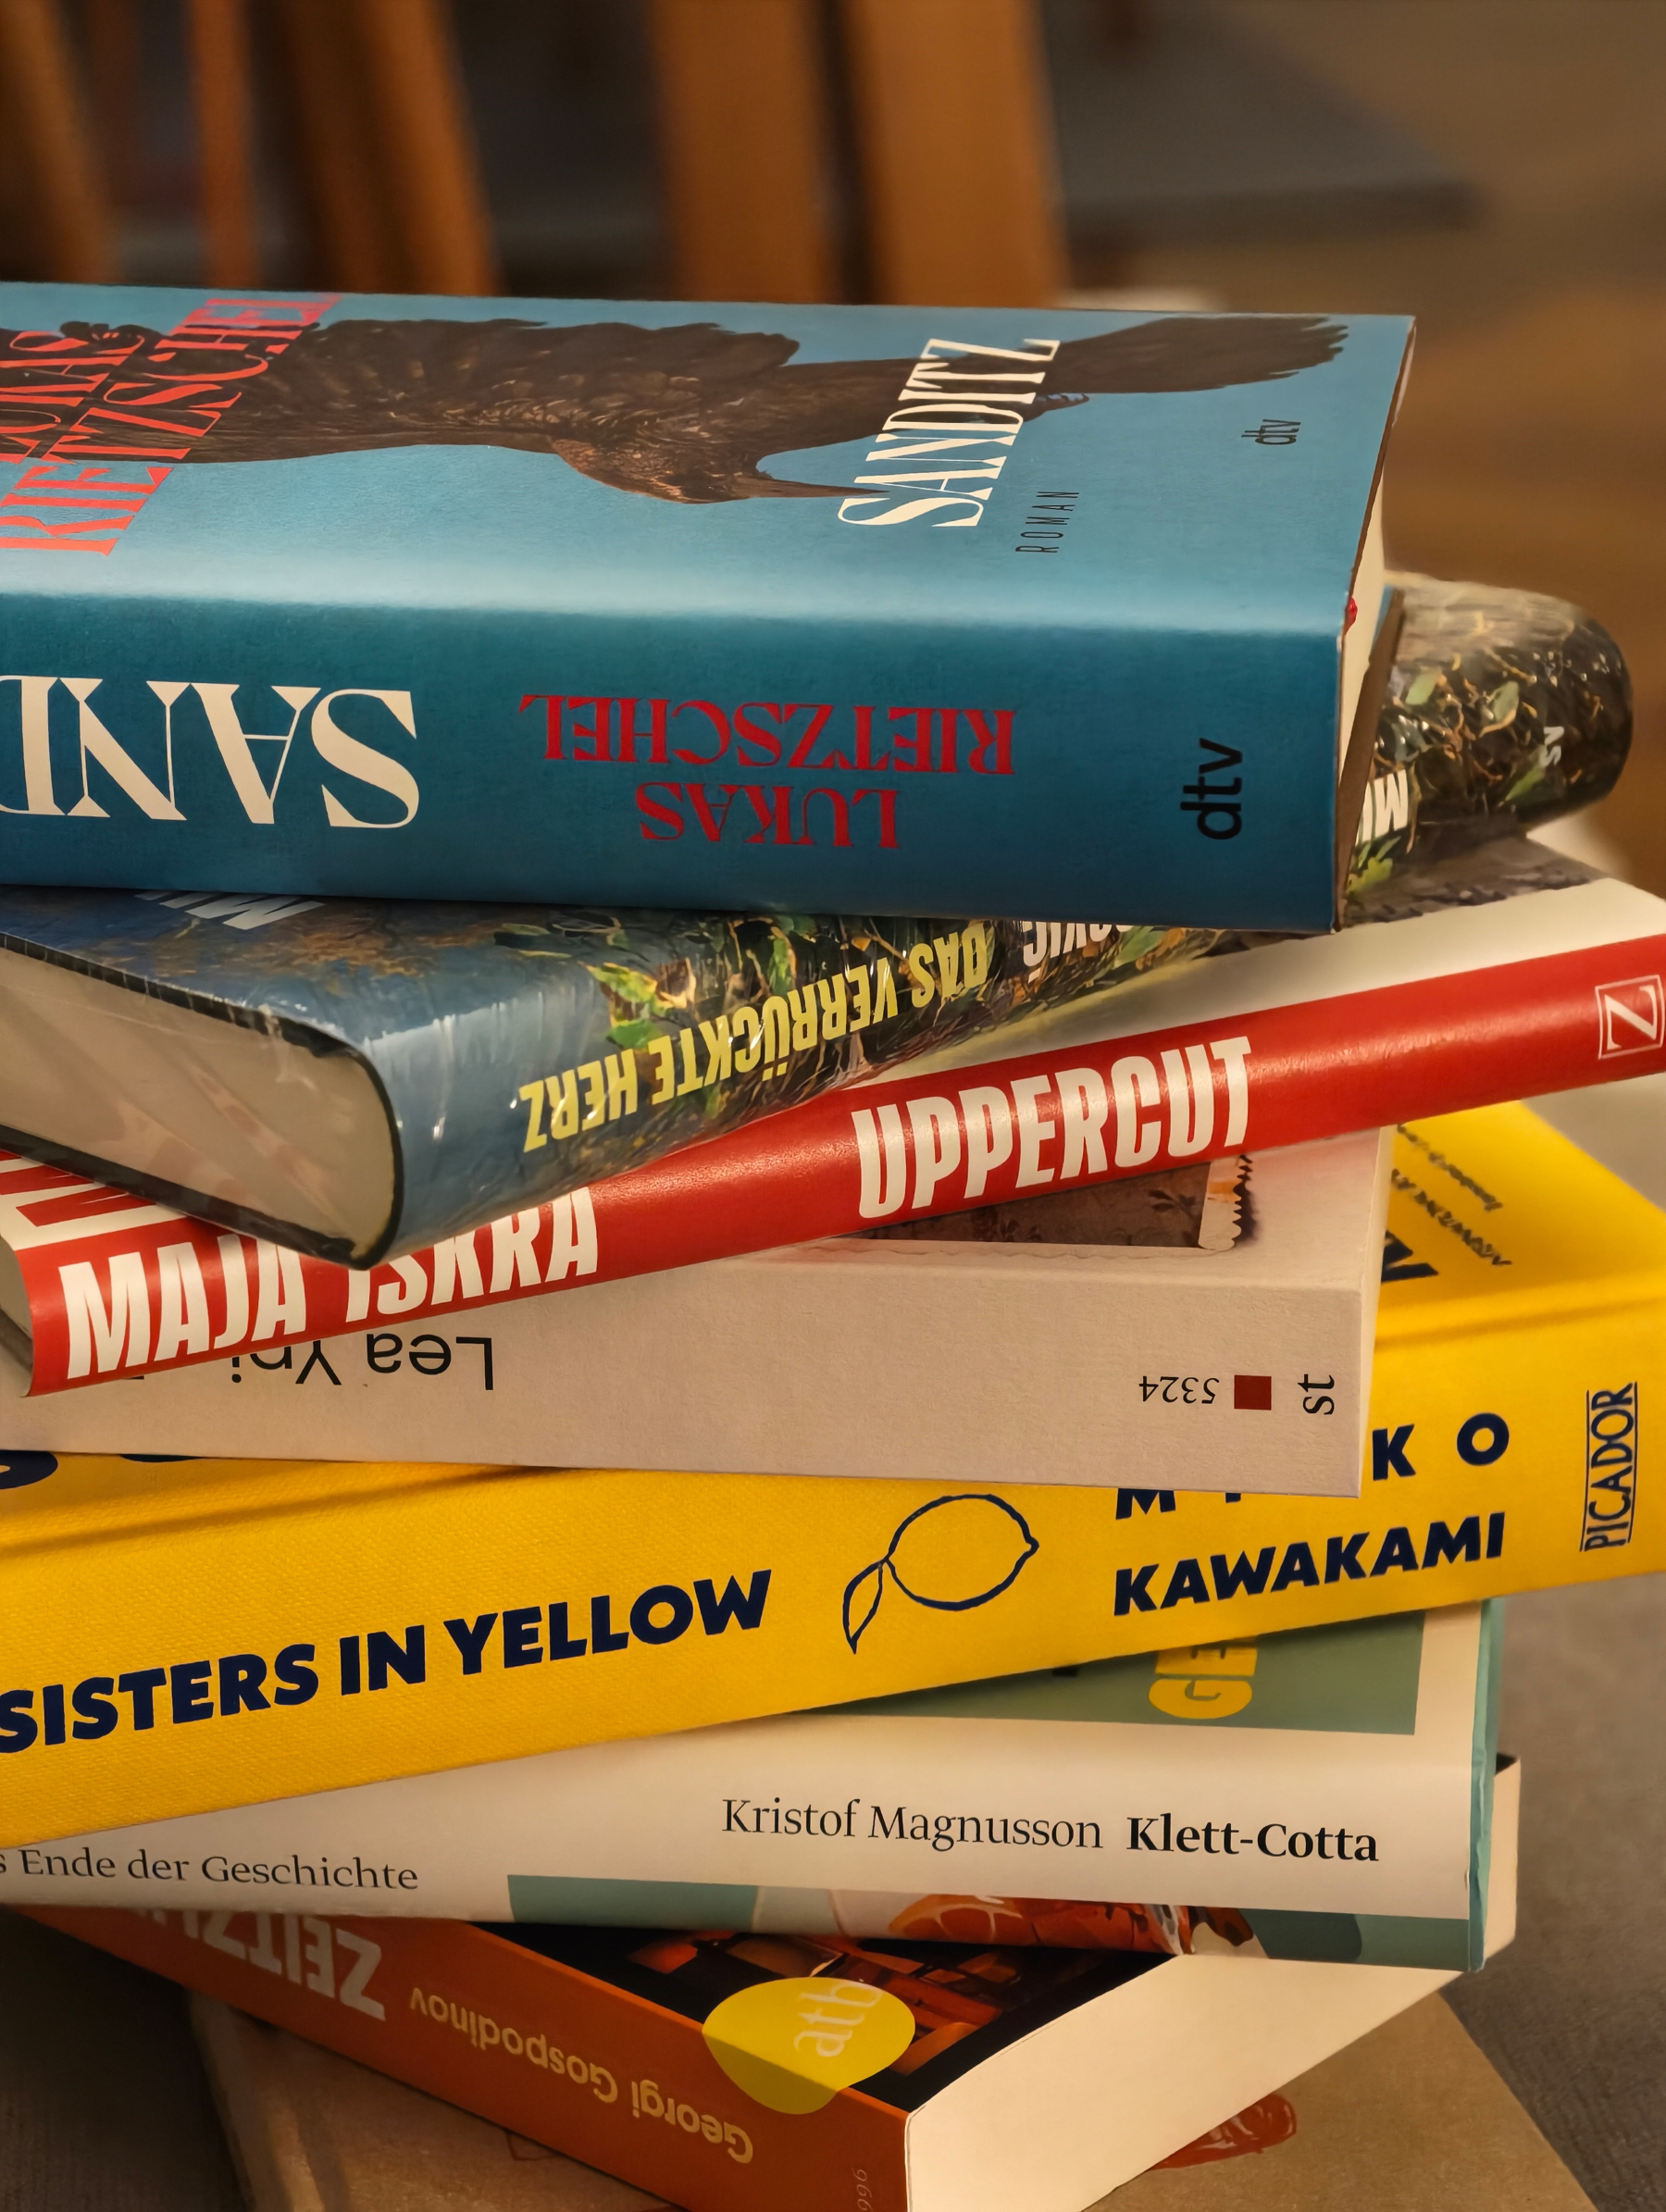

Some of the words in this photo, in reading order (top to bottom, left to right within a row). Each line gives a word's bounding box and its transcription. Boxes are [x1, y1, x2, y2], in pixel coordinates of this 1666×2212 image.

[838, 338, 1061, 528] SANDITZ
[1240, 418, 1301, 446] dtv
[1015, 491, 1080, 554] ROMAN
[519, 692, 1016, 776] RIETZSCHEL
[635, 780, 901, 850] LUKAS
[1178, 738, 1243, 840] dtv
[909, 918, 990, 1015] DAS
[648, 953, 900, 1107] VERRÜCKTE
[518, 1048, 639, 1153] HERZ
[59, 1231, 307, 1380] MAJA
[852, 1037, 1252, 1219] UPPERCUT
[367, 1333, 494, 1391] Lea
[1138, 1375, 1220, 1405] 5324
[1298, 1373, 1336, 1415] st
[1585, 1386, 1635, 1551] PICADOR
[1114, 1512, 1506, 1617] KAWAKAMI
[0, 1643, 319, 1754] SISTERS
[340, 1624, 426, 1696] IN
[443, 1569, 772, 1676] YELLOW
[20, 1847, 116, 1879] Ende
[128, 1849, 190, 1882] der
[201, 1855, 419, 1891] Geschichte
[722, 1797, 861, 1840] Kristof
[867, 1804, 1104, 1852] Magnusson
[1126, 1812, 1379, 1863] Klett-Cotta
[410, 1986, 618, 2104] Gospodinov
[793, 1977, 885, 2057] atb
[631, 2079, 753, 2164] Georgi
